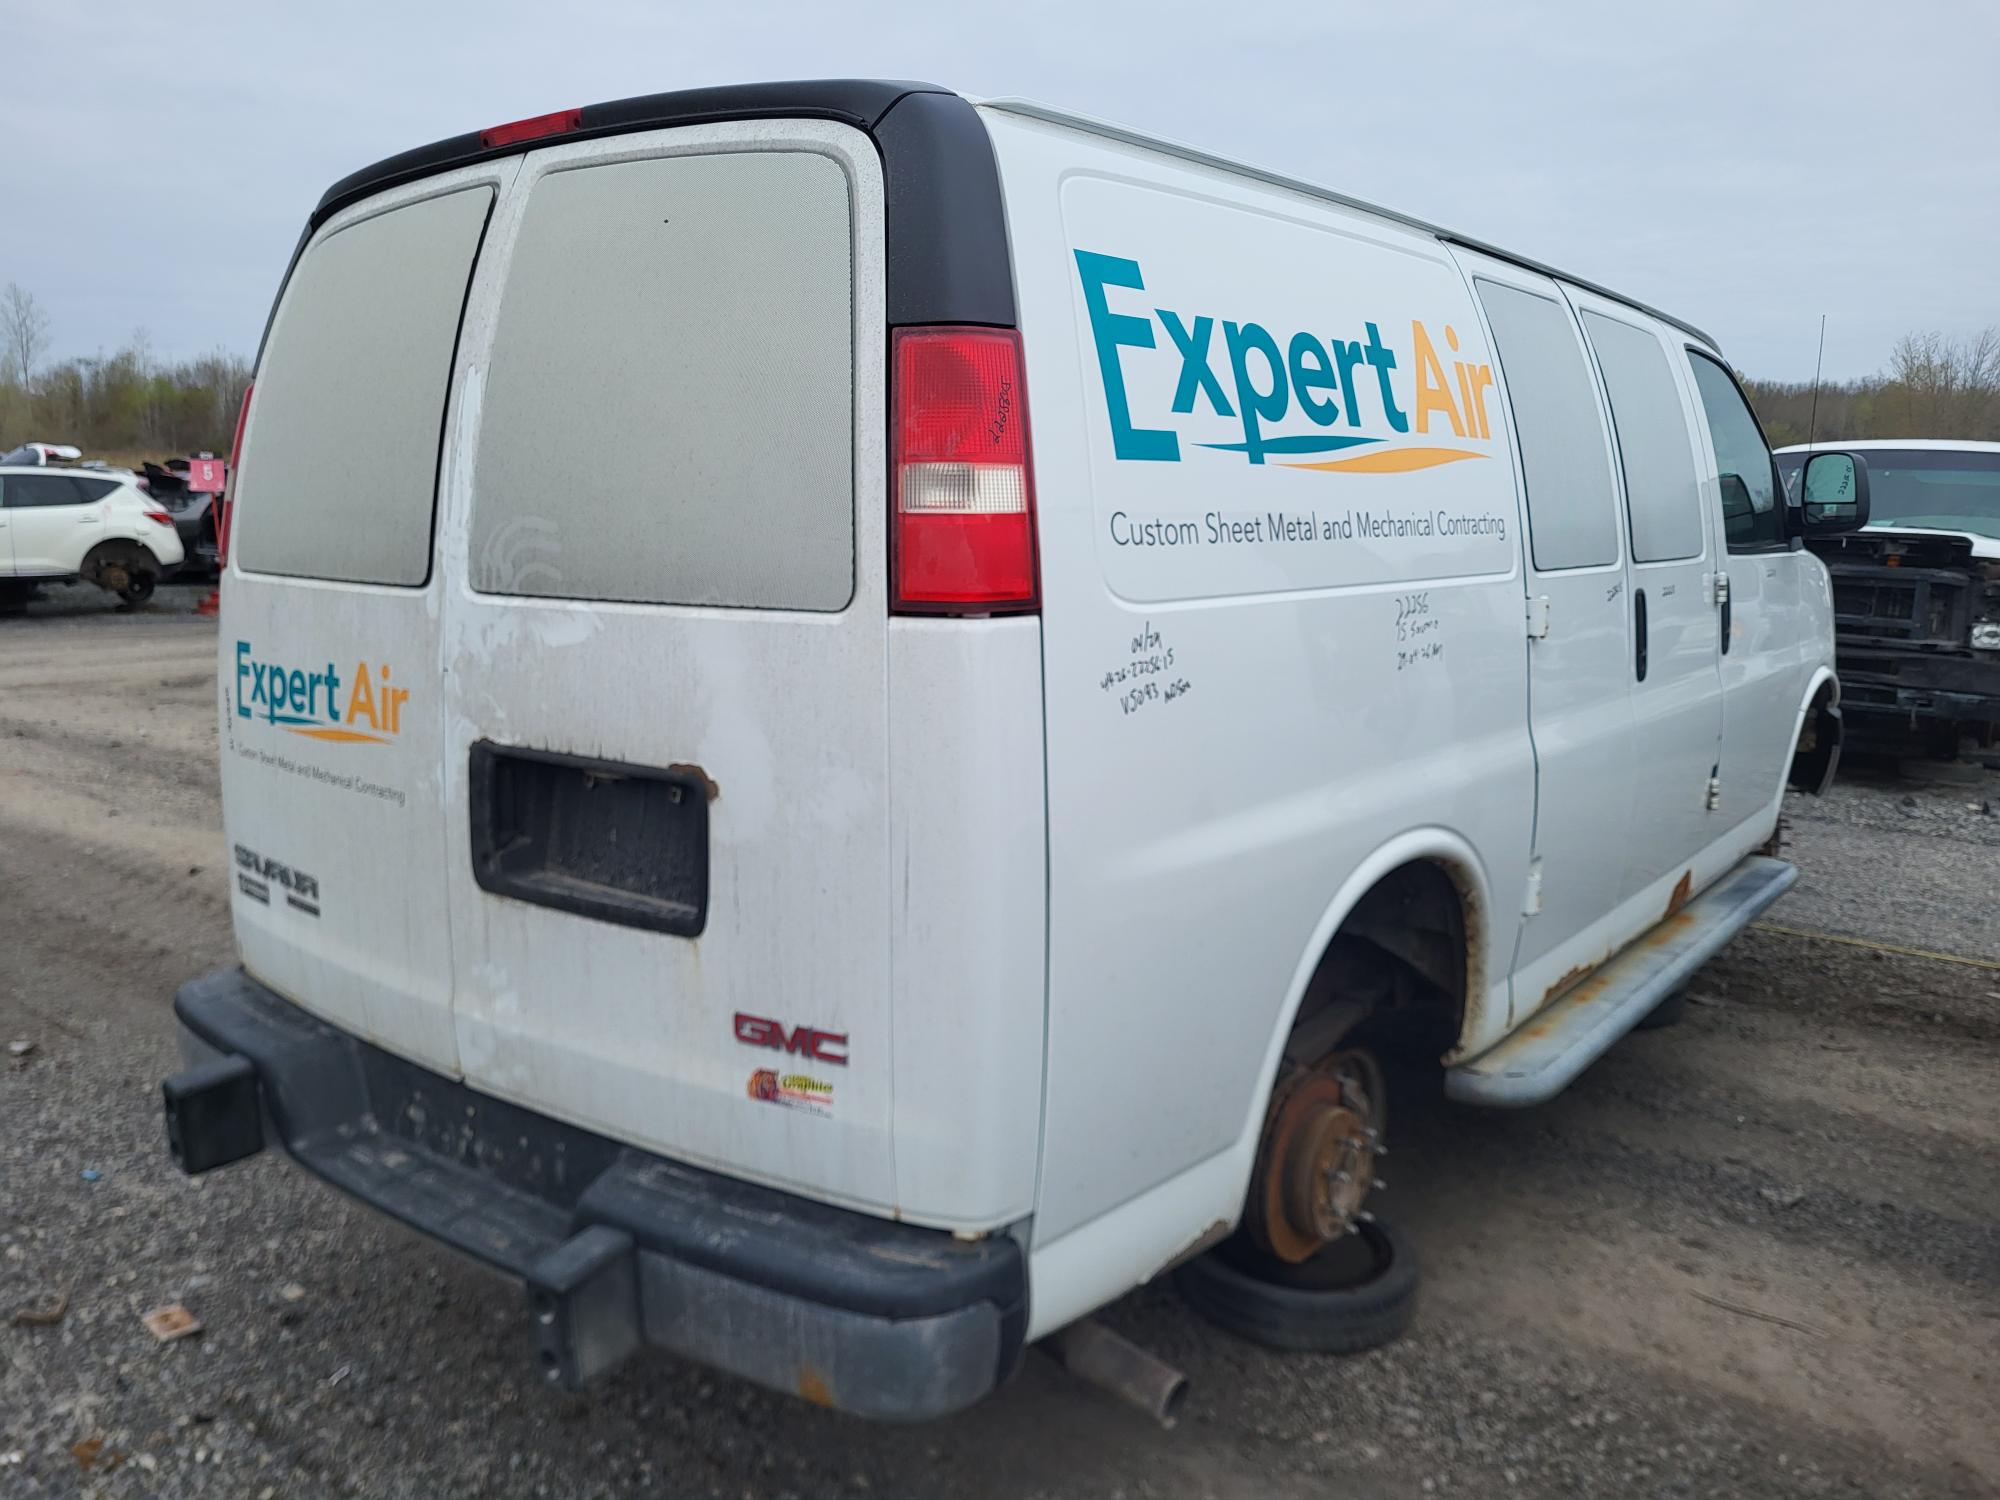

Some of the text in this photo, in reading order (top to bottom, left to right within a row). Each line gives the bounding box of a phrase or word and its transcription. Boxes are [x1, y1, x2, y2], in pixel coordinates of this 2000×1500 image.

[1073, 248, 1493, 465] Expert Air
[1110, 510, 1506, 546] Custom Sheet Metal and Mechanical Contracting
[237, 640, 340, 726] Expert
[346, 661, 410, 734] Air
[734, 1011, 849, 1067] GMC
